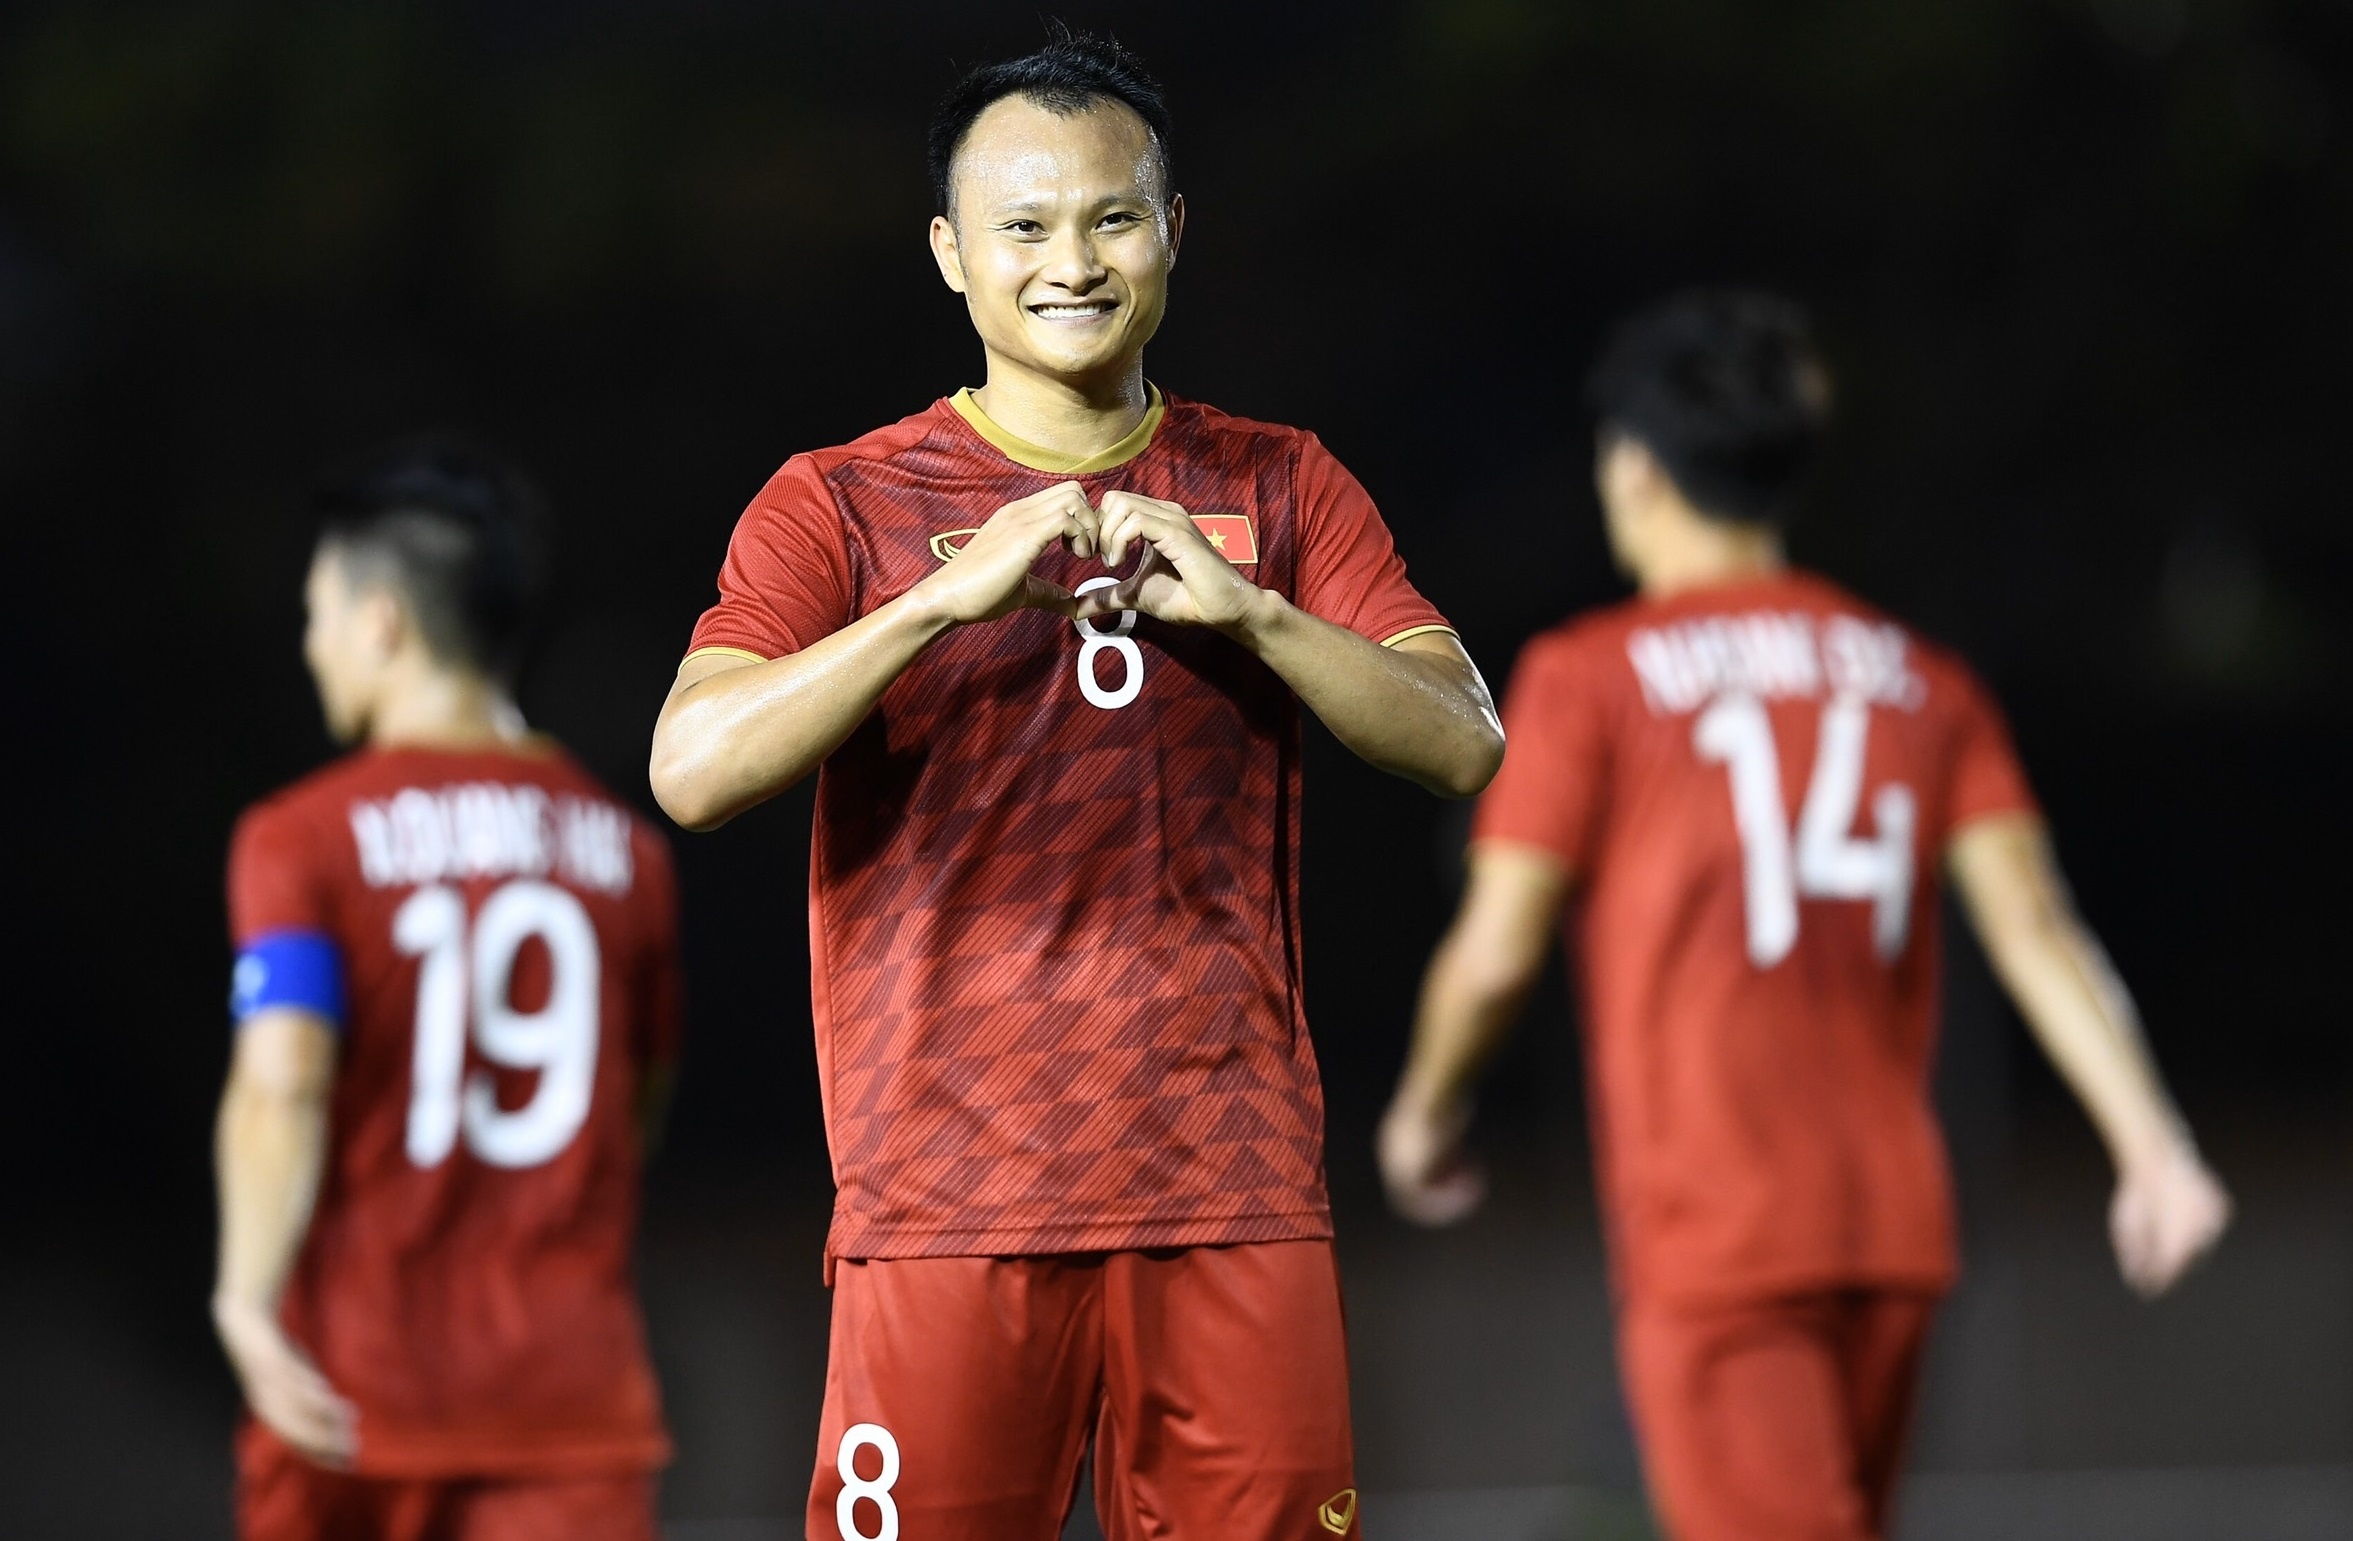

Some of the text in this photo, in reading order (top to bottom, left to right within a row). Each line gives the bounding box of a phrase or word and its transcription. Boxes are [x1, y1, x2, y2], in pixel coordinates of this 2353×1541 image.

[1073, 577, 1144, 709] 8
[1693, 694, 1917, 969] 14
[393, 880, 600, 1168] 19
[836, 1422, 899, 1541] 8
